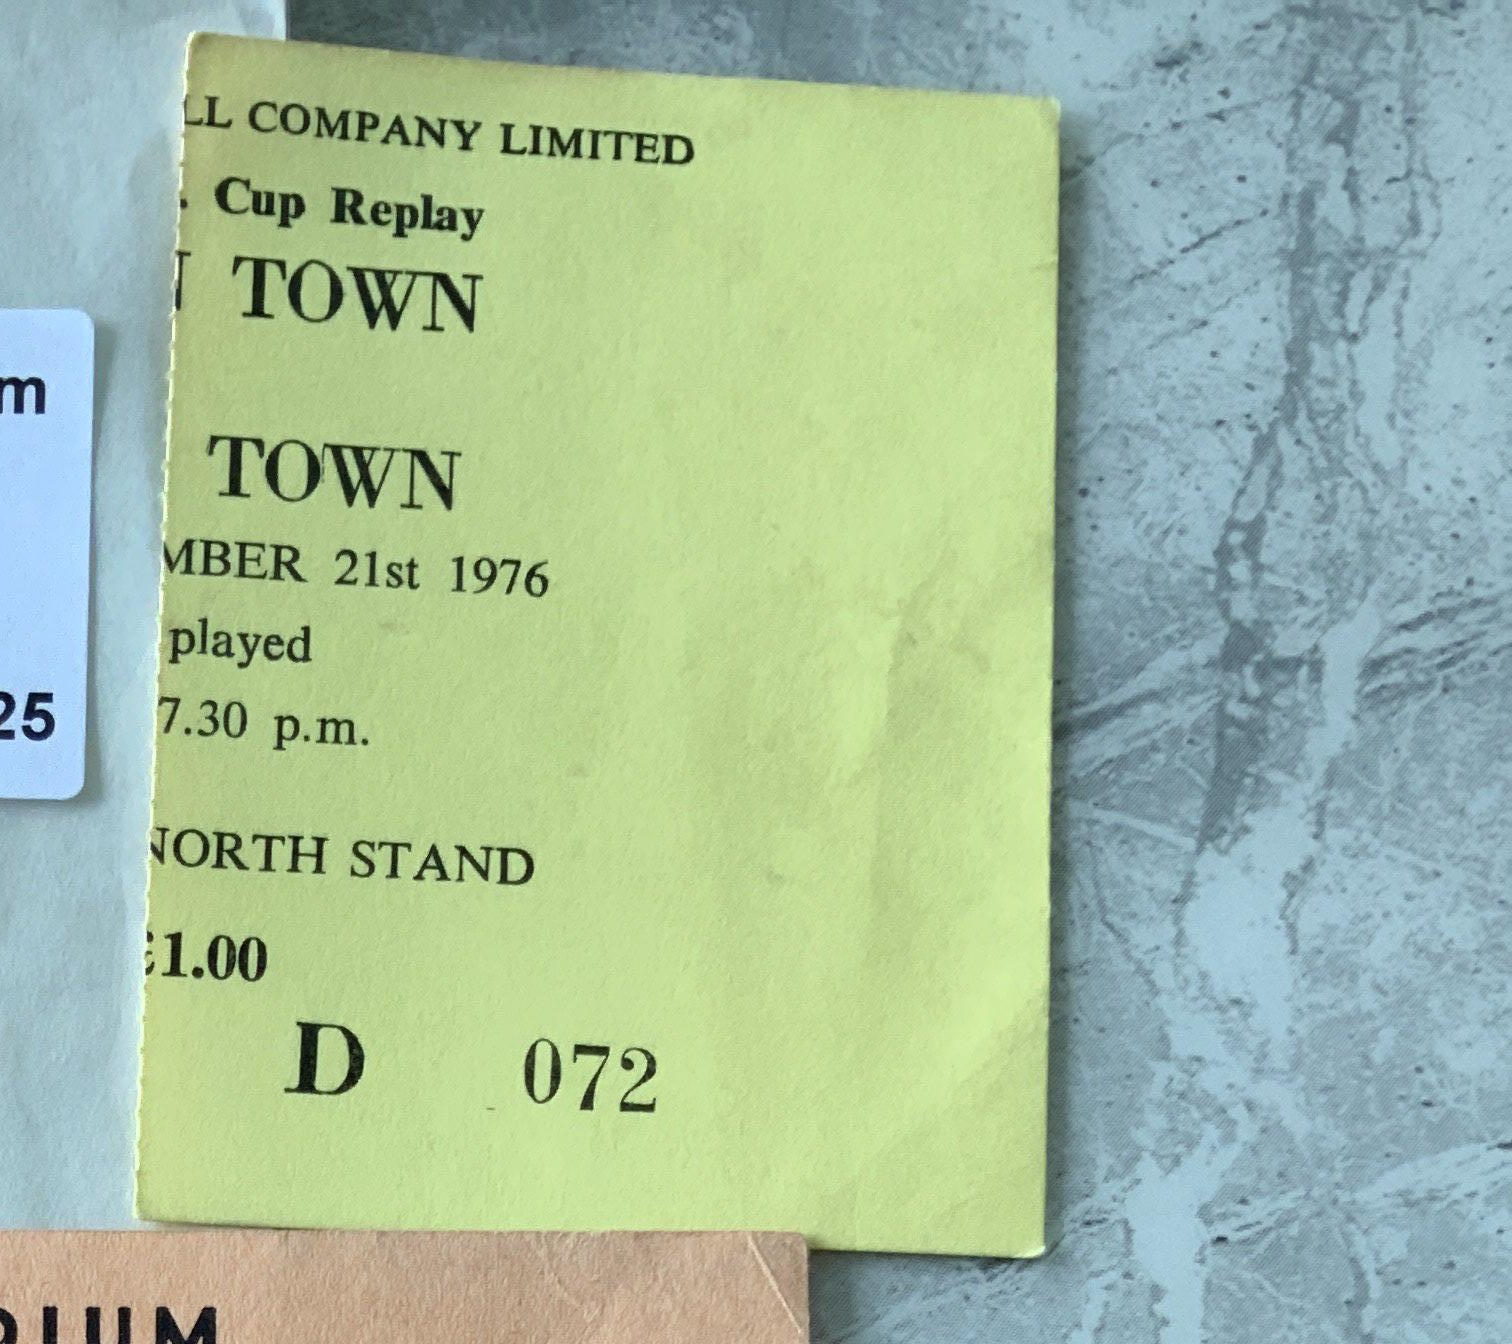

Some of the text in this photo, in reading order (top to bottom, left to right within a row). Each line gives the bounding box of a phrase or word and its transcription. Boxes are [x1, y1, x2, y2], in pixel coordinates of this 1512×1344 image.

[248, 101, 482, 151] COMPANY
[500, 123, 695, 165] LIMITED
[214, 176, 484, 242] Cup Replay
[232, 255, 484, 333] TOWN
[207, 434, 462, 511] TOWN
[163, 538, 549, 598] MBER 21st 1976
[168, 617, 312, 669] played
[158, 696, 369, 751] 7.30 p.m.
[350, 839, 535, 886] STAND
[284, 1021, 657, 1113] D 072
